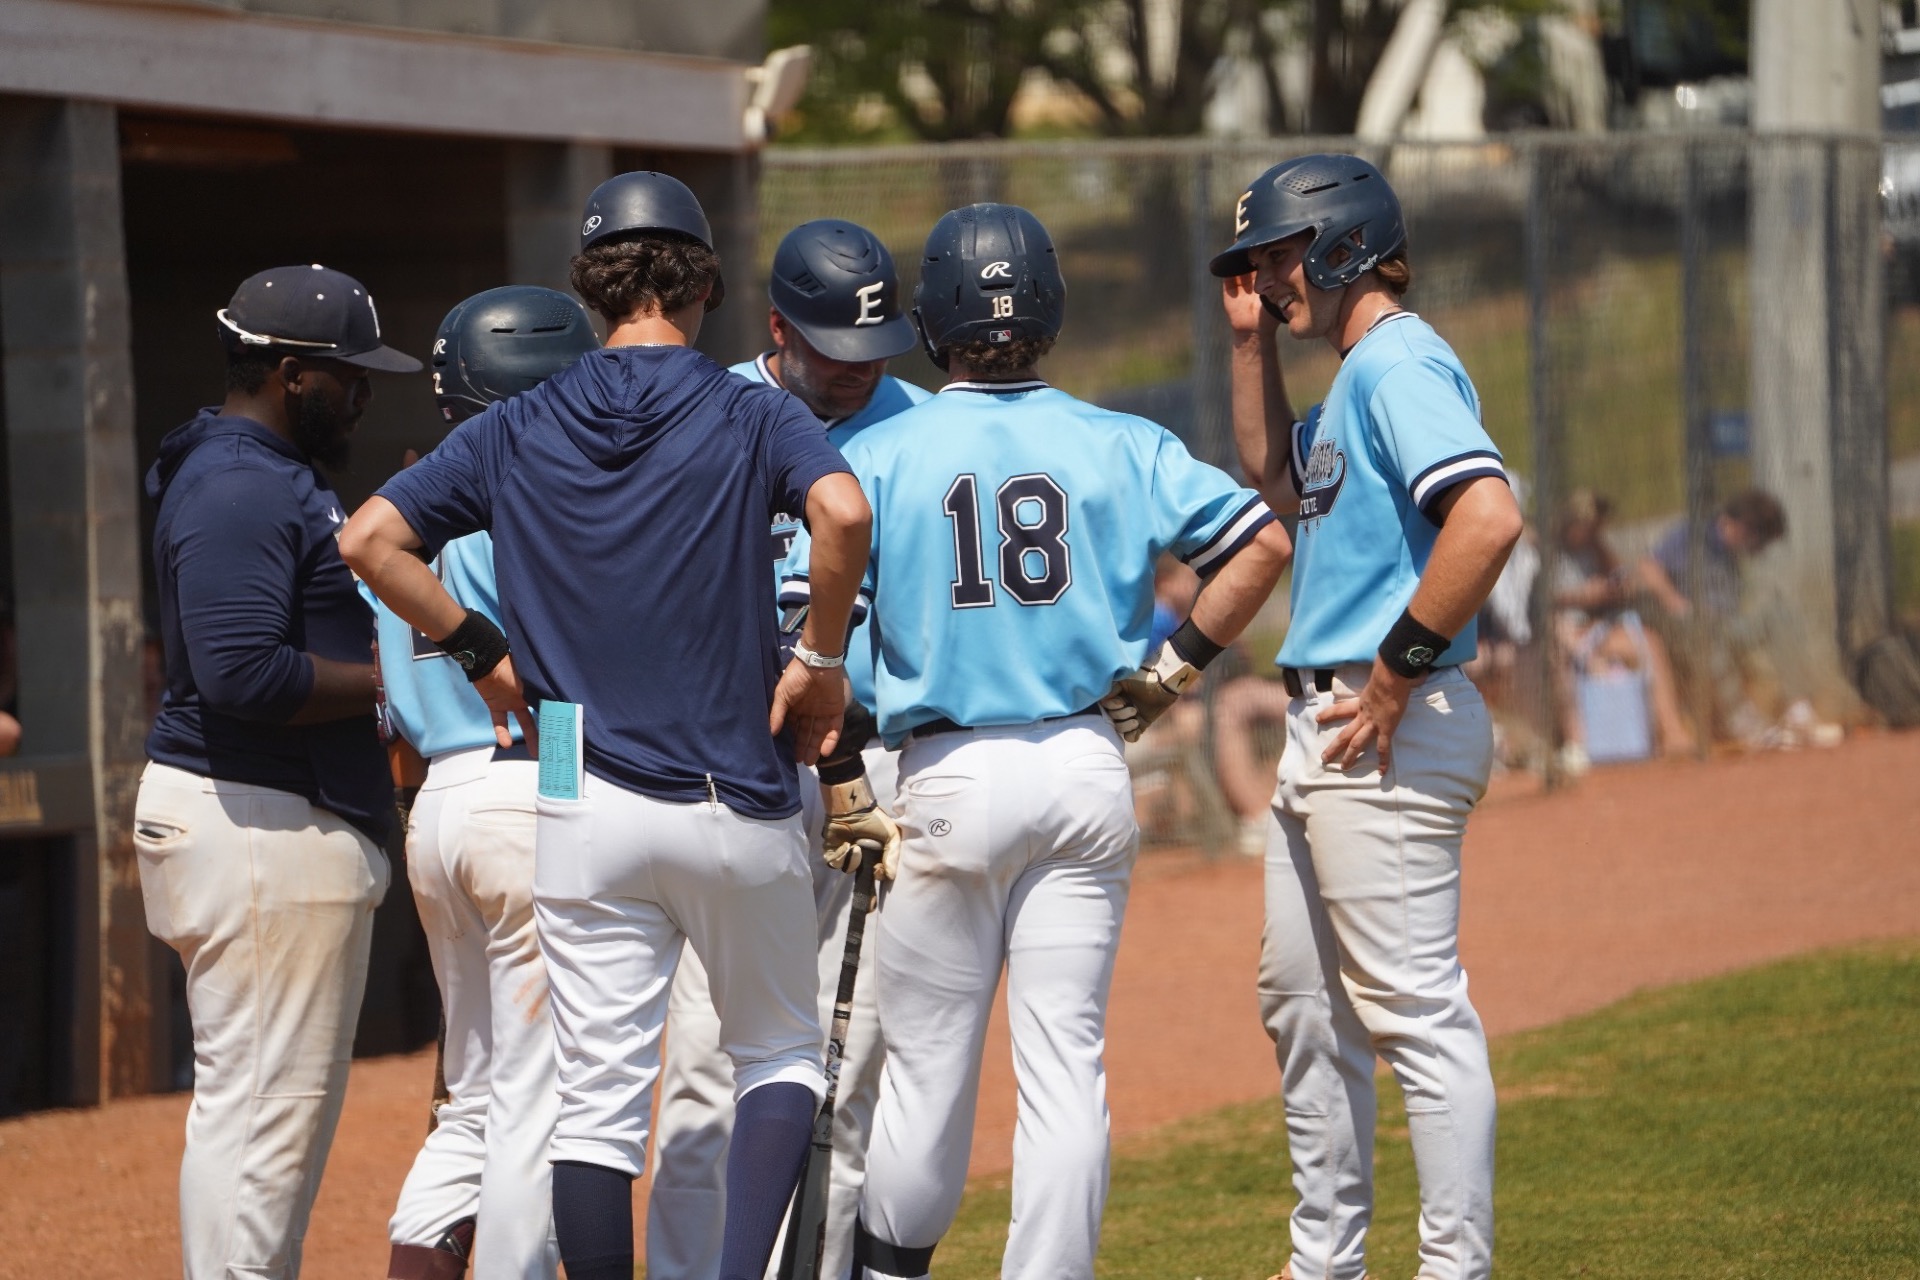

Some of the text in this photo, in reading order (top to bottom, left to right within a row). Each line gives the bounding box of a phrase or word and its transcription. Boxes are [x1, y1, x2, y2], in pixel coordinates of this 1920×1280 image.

[1235, 190, 1253, 235] E
[981, 261, 1012, 280] R
[855, 281, 884, 325] E
[992, 295, 1013, 319] 18
[942, 472, 1073, 611] 18
